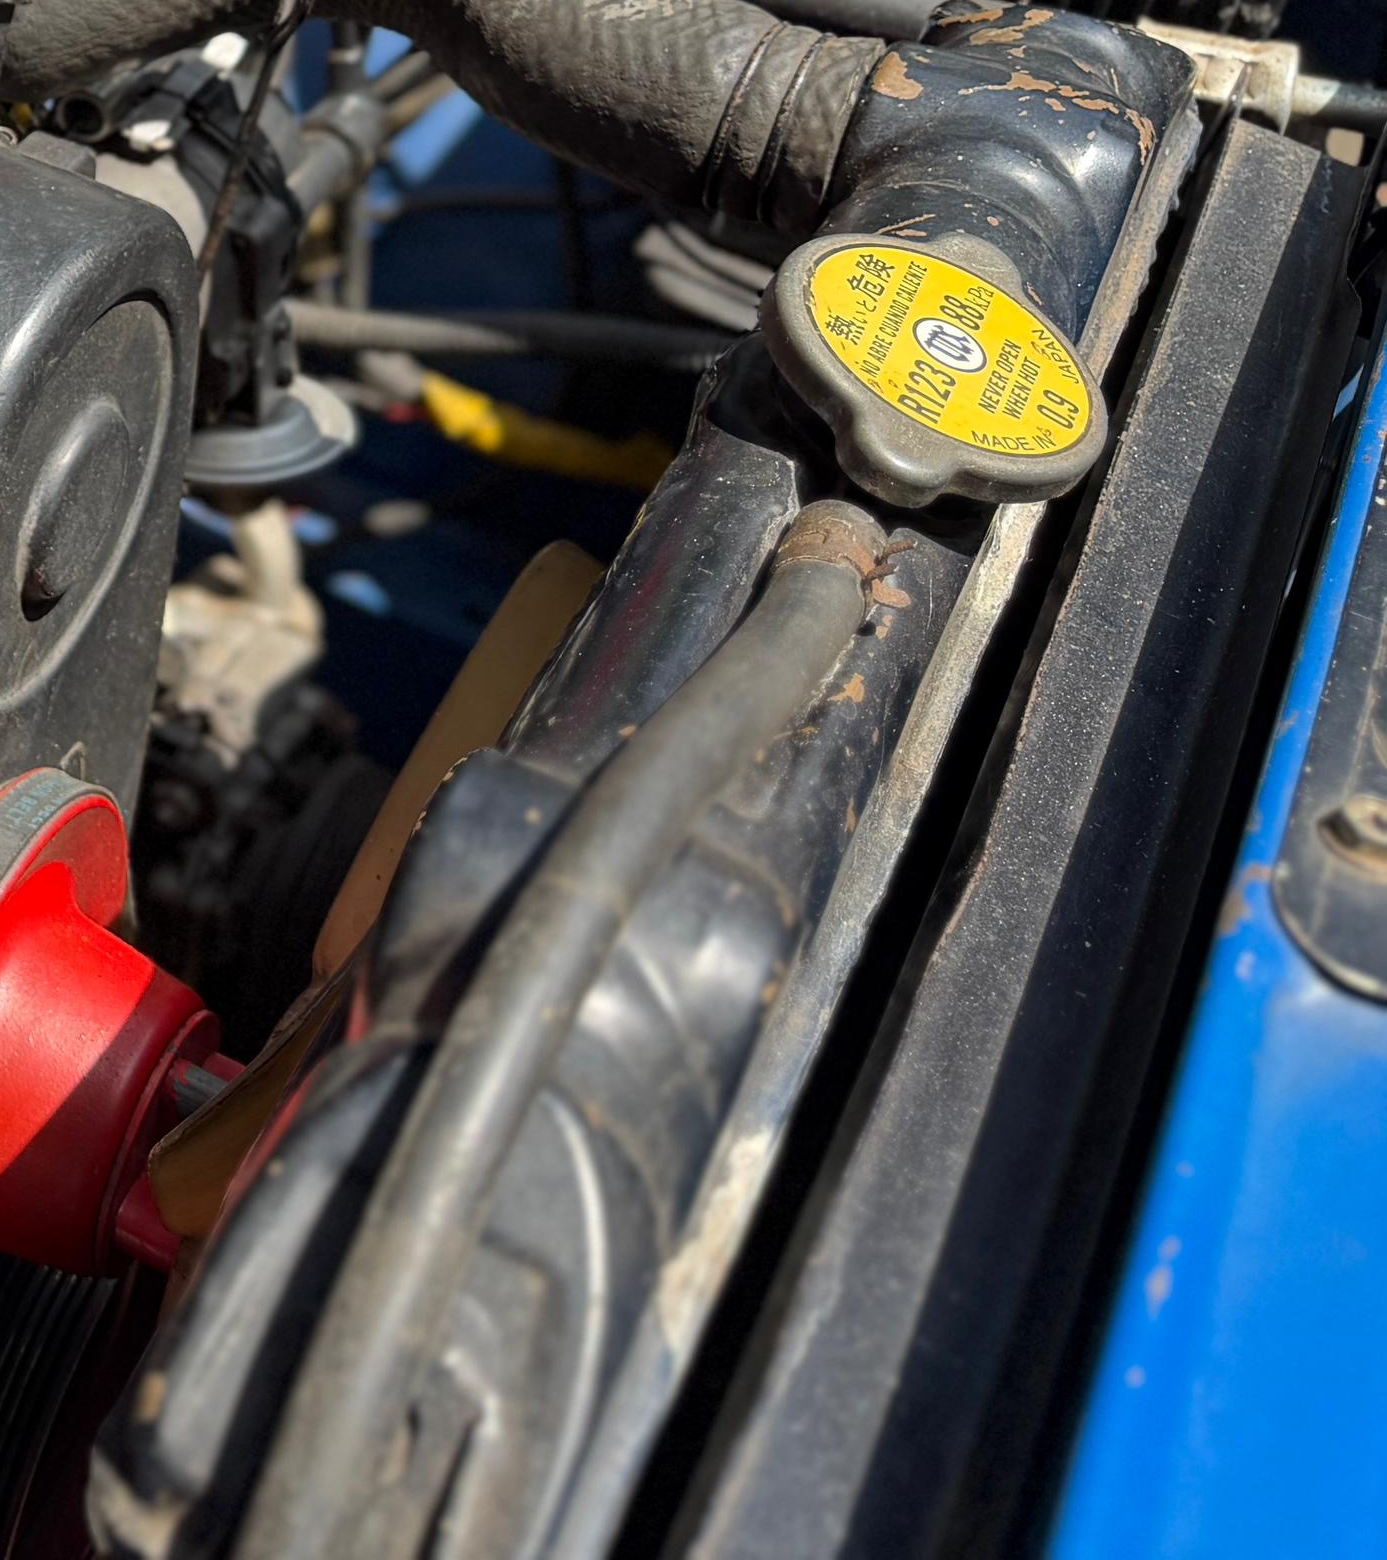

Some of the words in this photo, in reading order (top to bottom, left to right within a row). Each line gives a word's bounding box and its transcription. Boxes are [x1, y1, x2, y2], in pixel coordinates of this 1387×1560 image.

[896, 261, 928, 303] CALIENTE
[879, 299, 910, 338] CUANDO
[859, 360, 881, 378] NO
[867, 335, 893, 363] ABRE
[1031, 329, 1079, 384] JAPAN
[897, 359, 957, 424] R123
[978, 370, 1009, 415] NEVER
[996, 339, 1022, 374] OPEN
[1002, 381, 1031, 419] WHEN
[1018, 356, 1041, 385] HOT
[1037, 389, 1080, 429] 0.9
[971, 430, 1035, 451] MADE
[1032, 432, 1057, 449] IN
